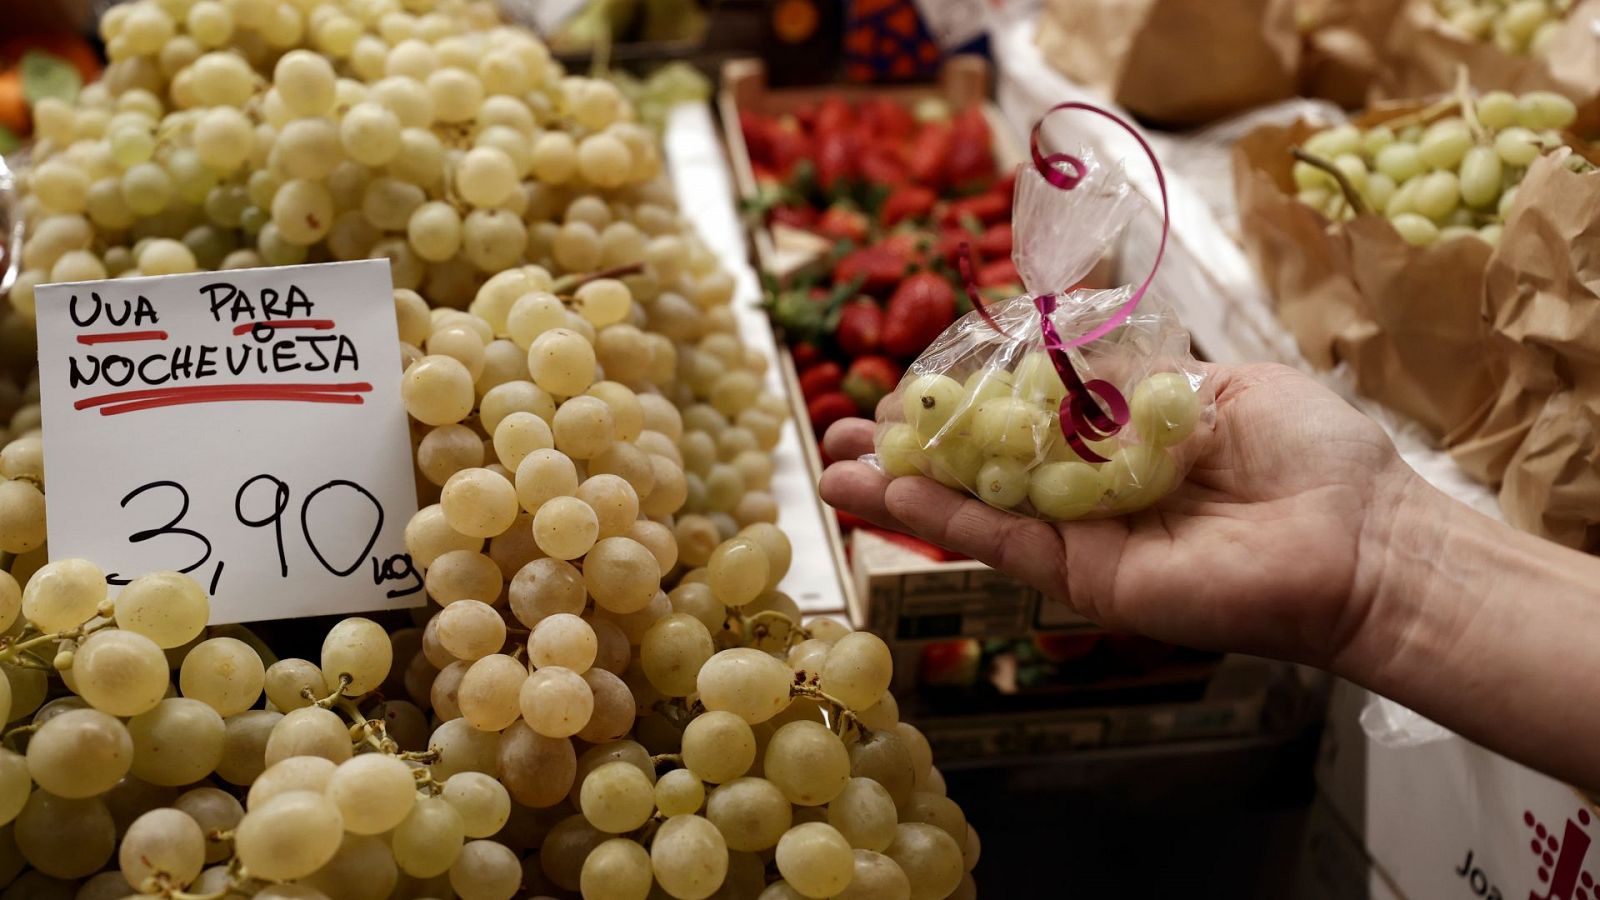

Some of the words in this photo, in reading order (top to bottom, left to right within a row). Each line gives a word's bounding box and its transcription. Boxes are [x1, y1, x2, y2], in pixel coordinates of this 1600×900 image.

[200, 282, 315, 322] PARA
[105, 473, 384, 595] 3,90
[372, 553, 425, 598] kg
